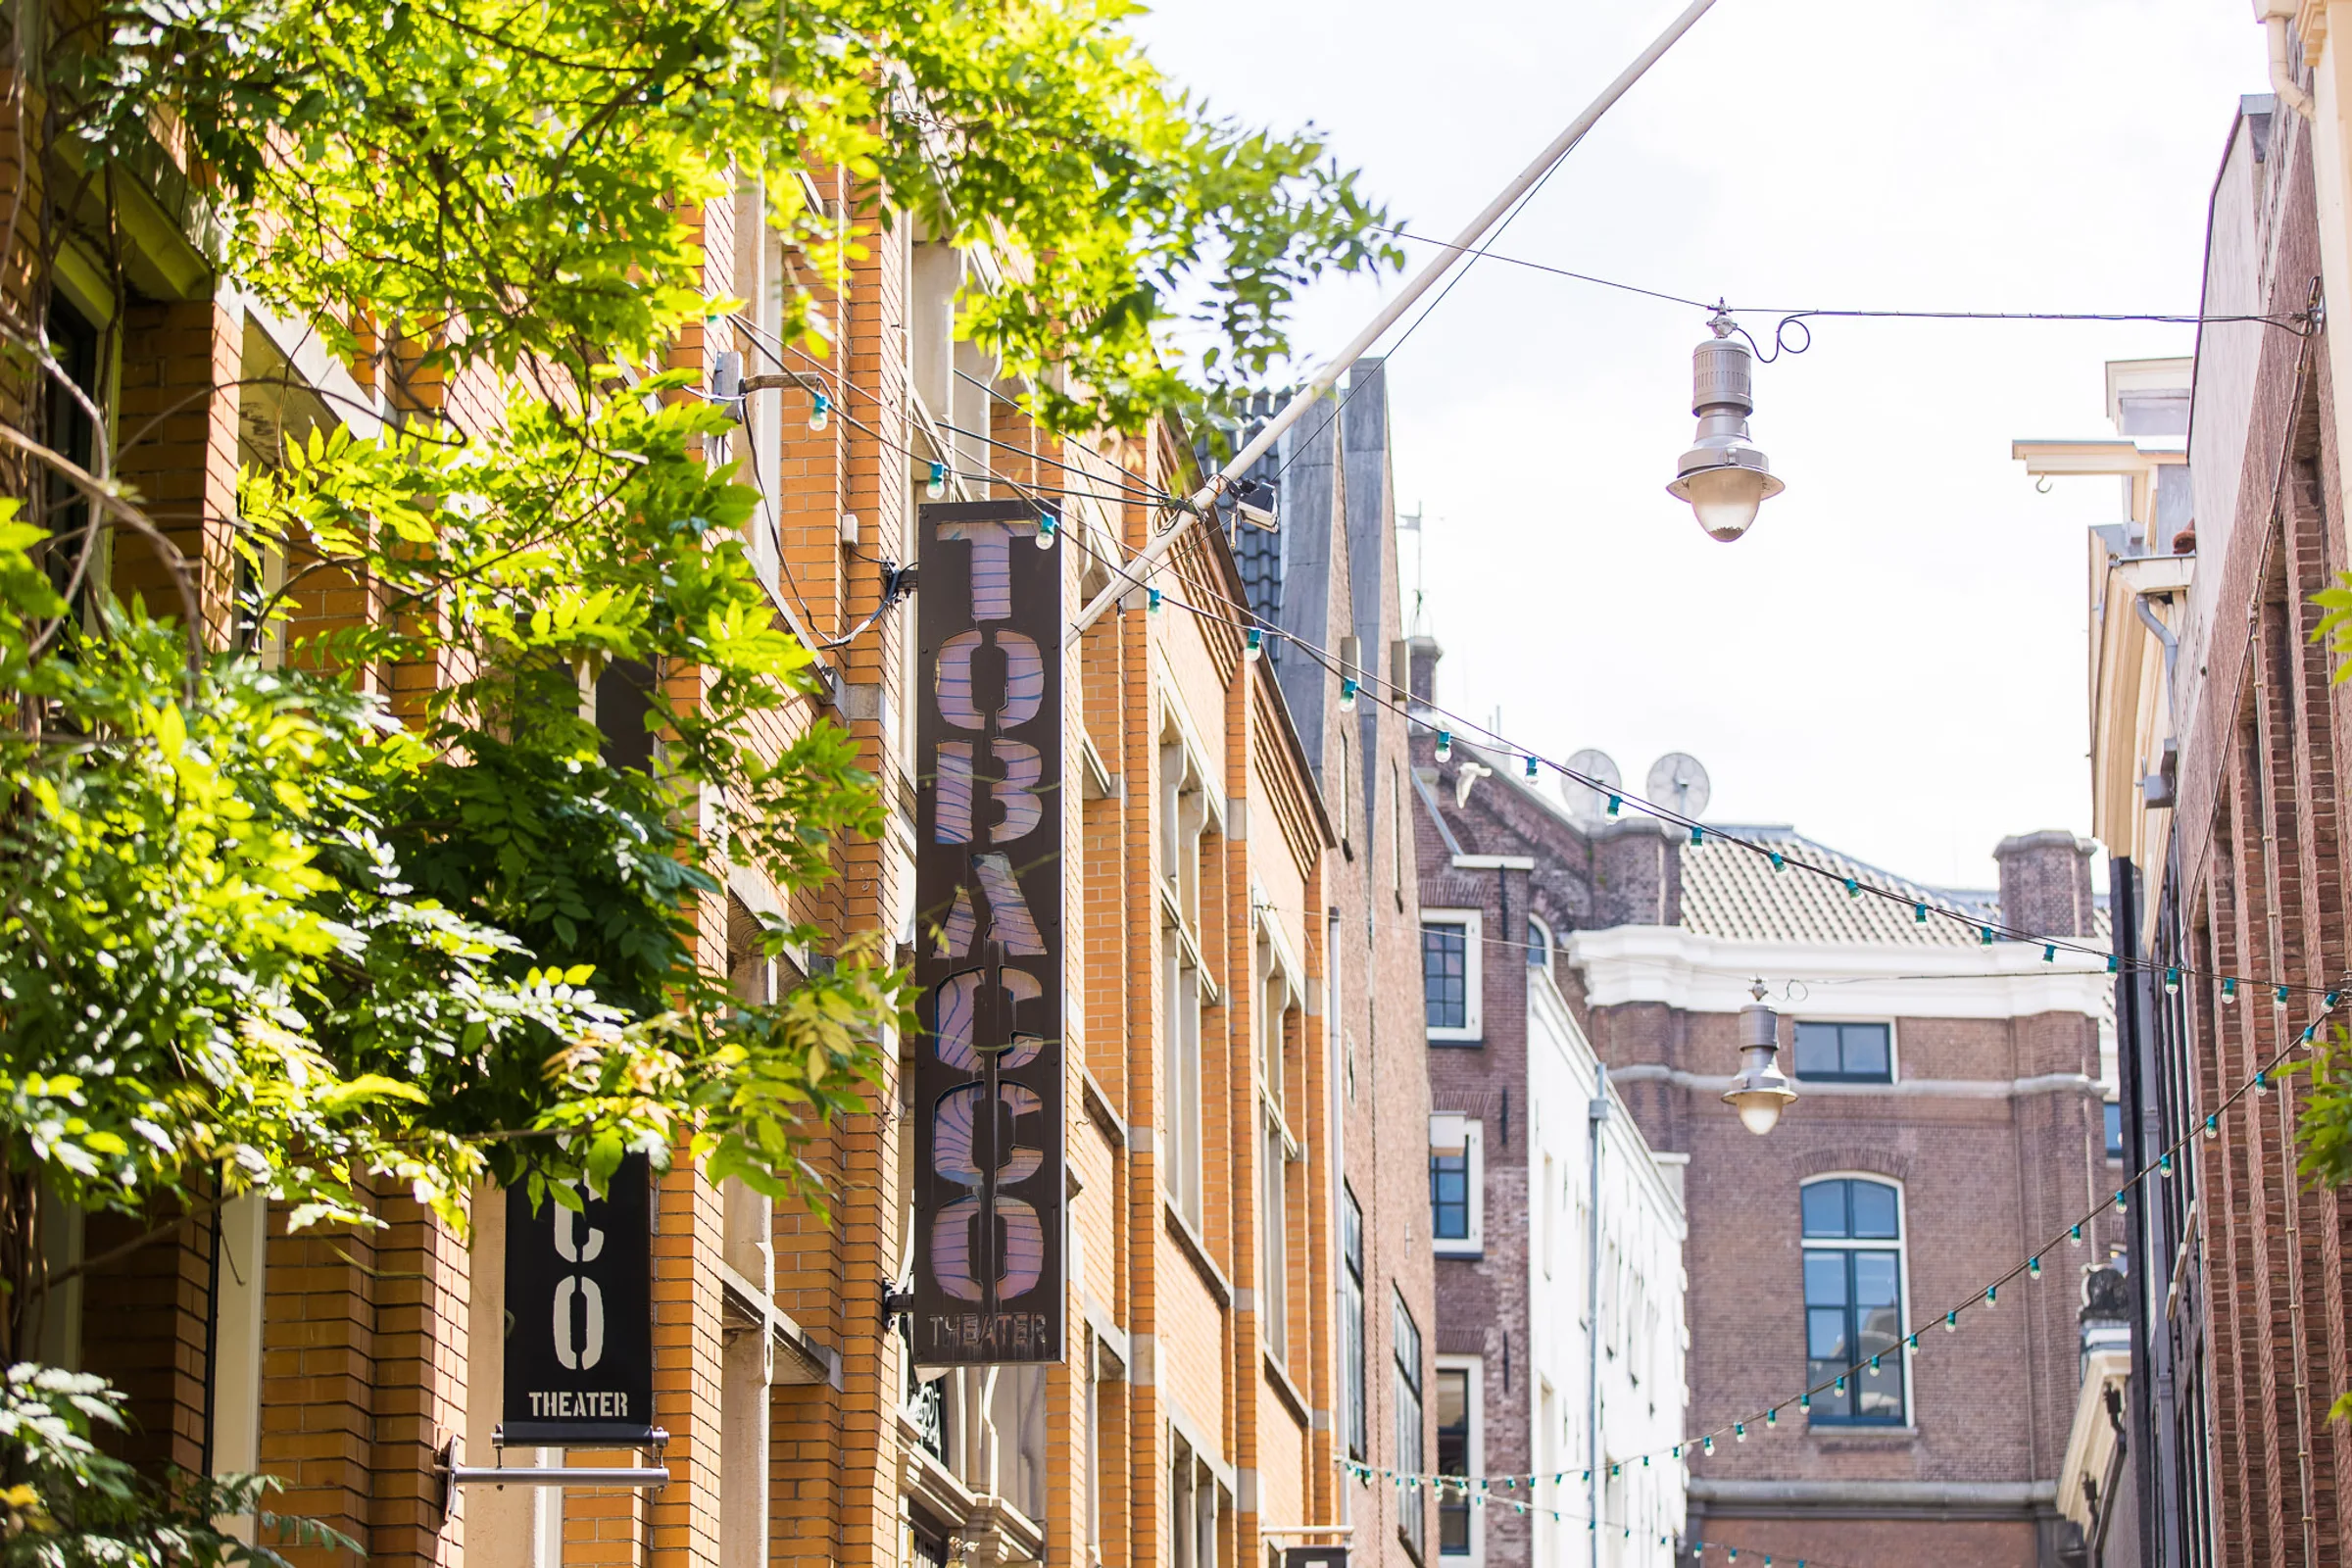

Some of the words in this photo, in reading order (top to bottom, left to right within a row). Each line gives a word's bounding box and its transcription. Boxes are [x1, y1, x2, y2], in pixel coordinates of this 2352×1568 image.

[931, 520, 1048, 1301] TOBACCO
[928, 1313, 1047, 1347] THEATER
[528, 1392, 628, 1417] THEATER
